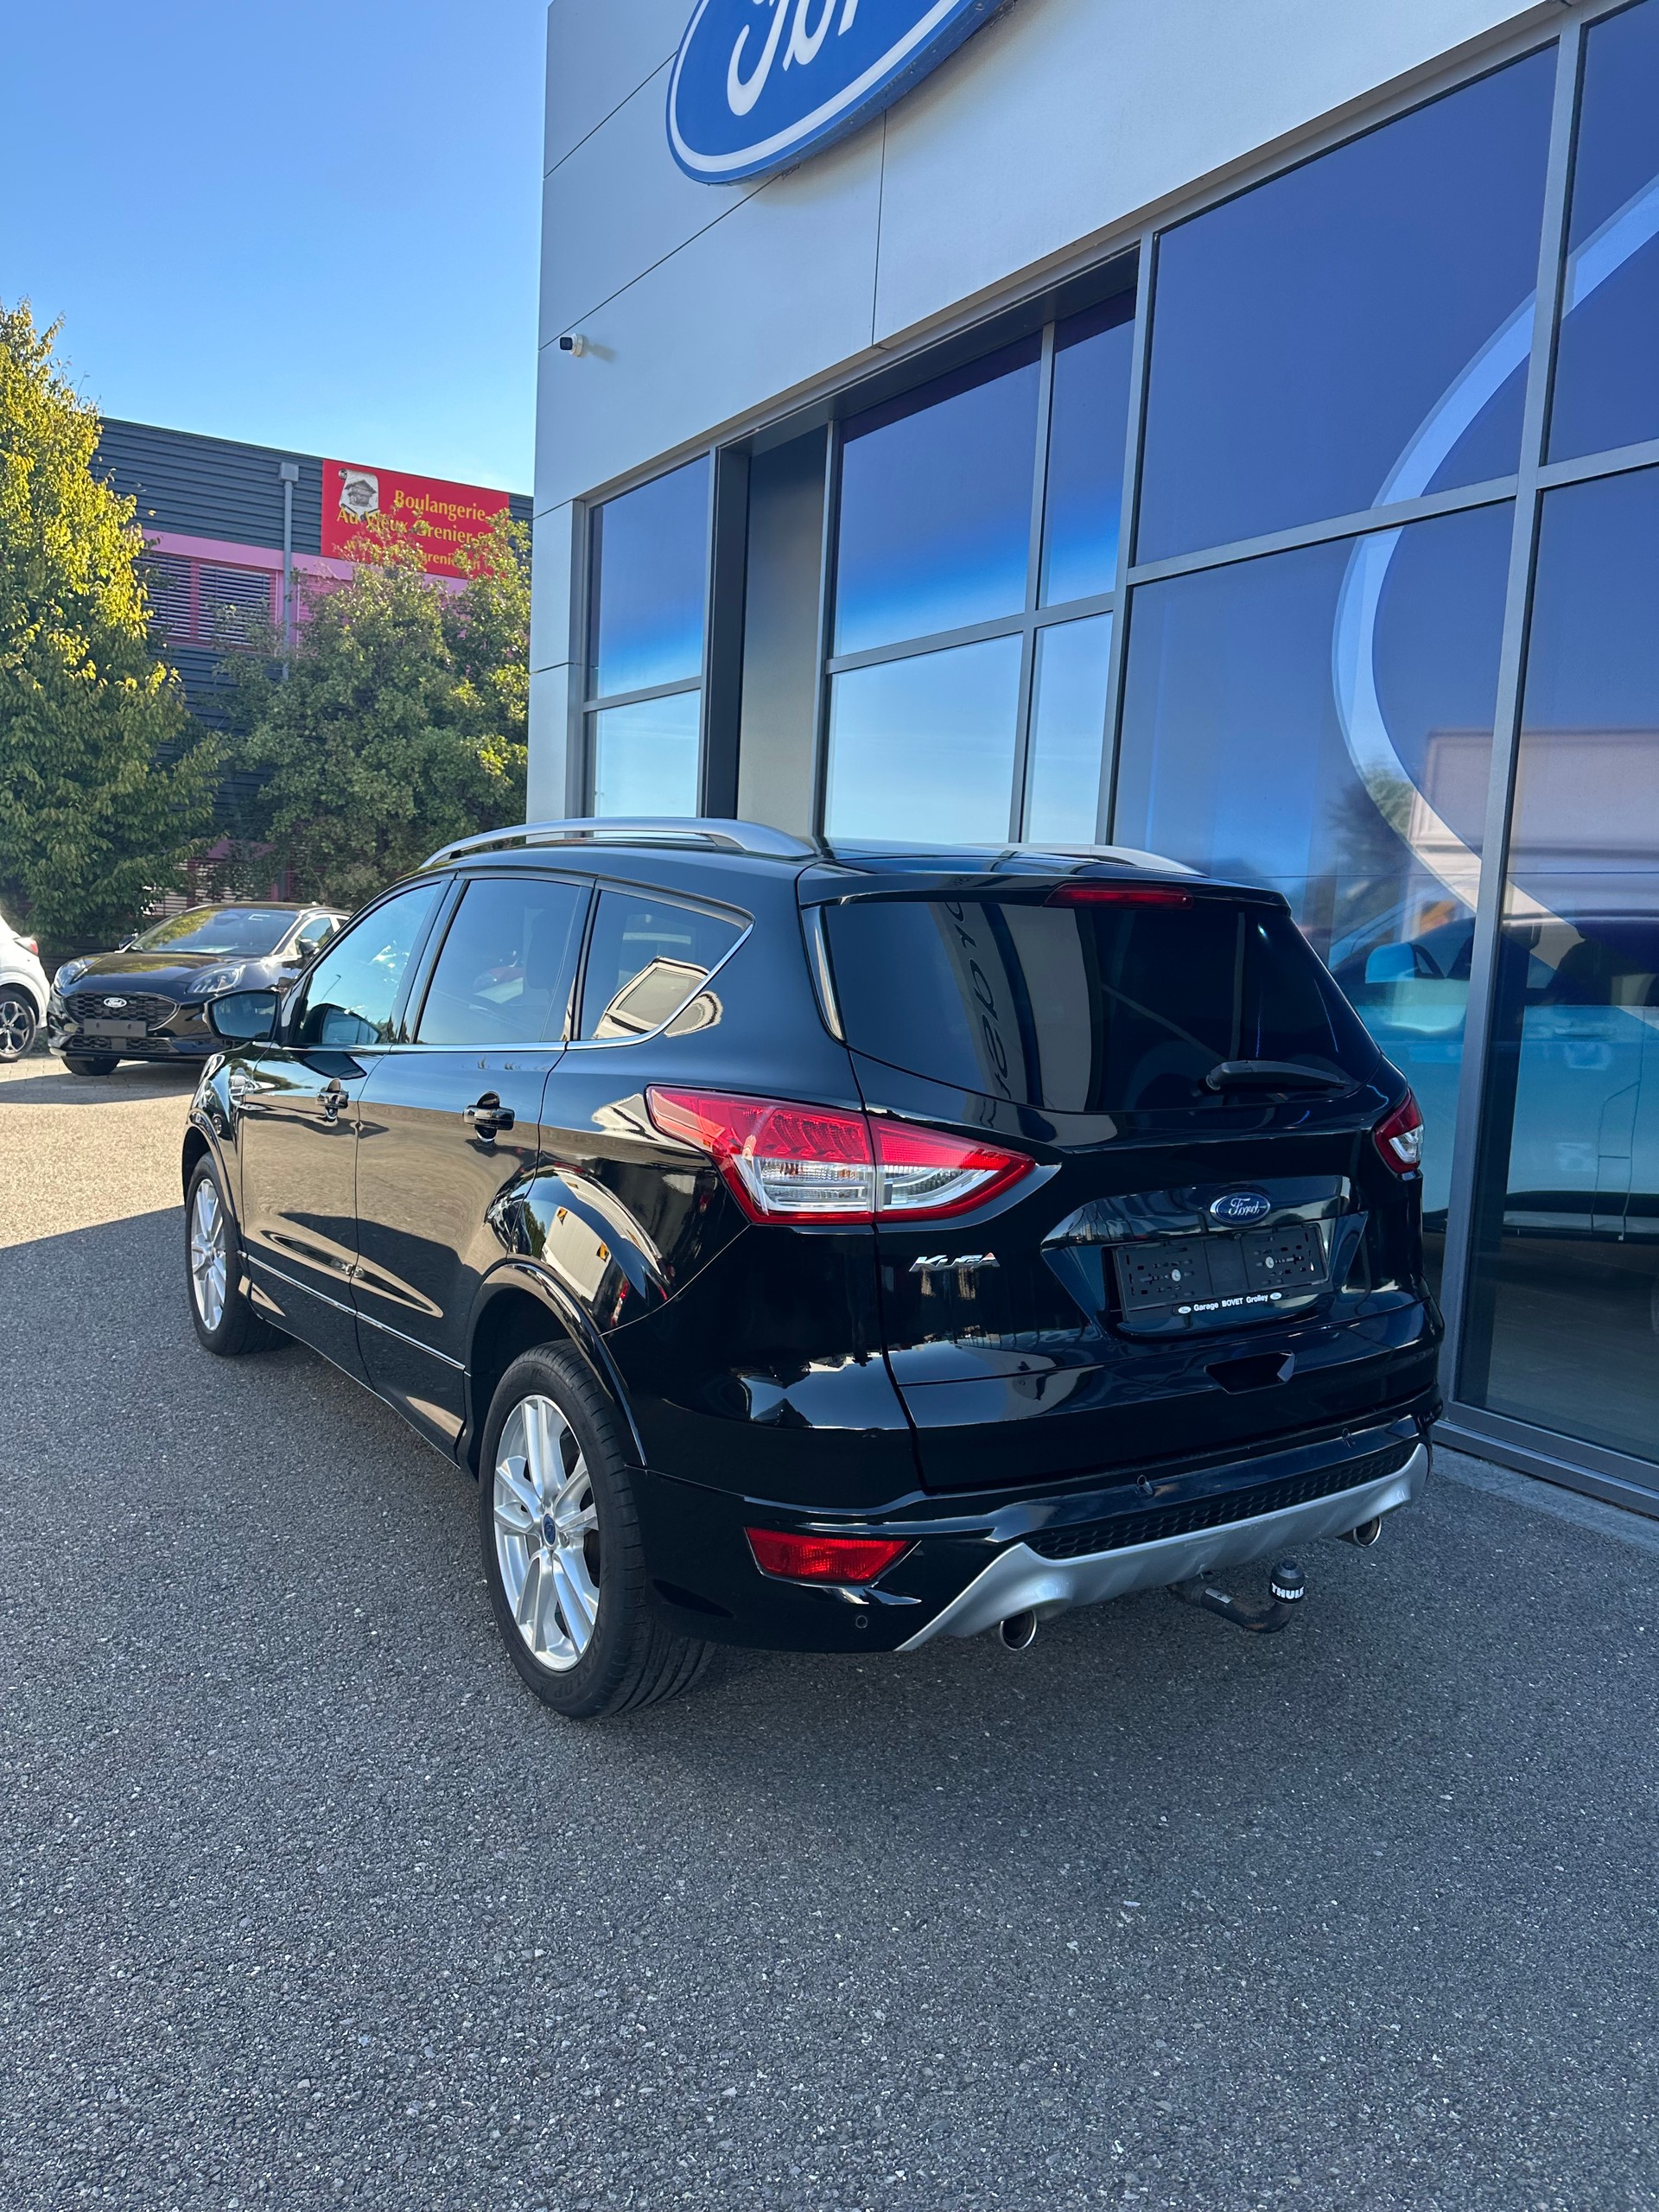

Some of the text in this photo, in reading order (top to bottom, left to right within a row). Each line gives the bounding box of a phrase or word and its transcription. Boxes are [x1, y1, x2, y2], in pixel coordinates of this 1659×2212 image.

[394, 489, 486, 522] Boulangerie
[336, 505, 359, 525] Au
[414, 519, 472, 544] Grenier
[1228, 1198, 1261, 1217] Ford
[909, 1252, 1001, 1273] KUGA
[1193, 1302, 1219, 1312] Garage
[1221, 1298, 1244, 1307] BOVET
[1246, 1294, 1268, 1304] Grolley
[1271, 1582, 1305, 1599] THULE
